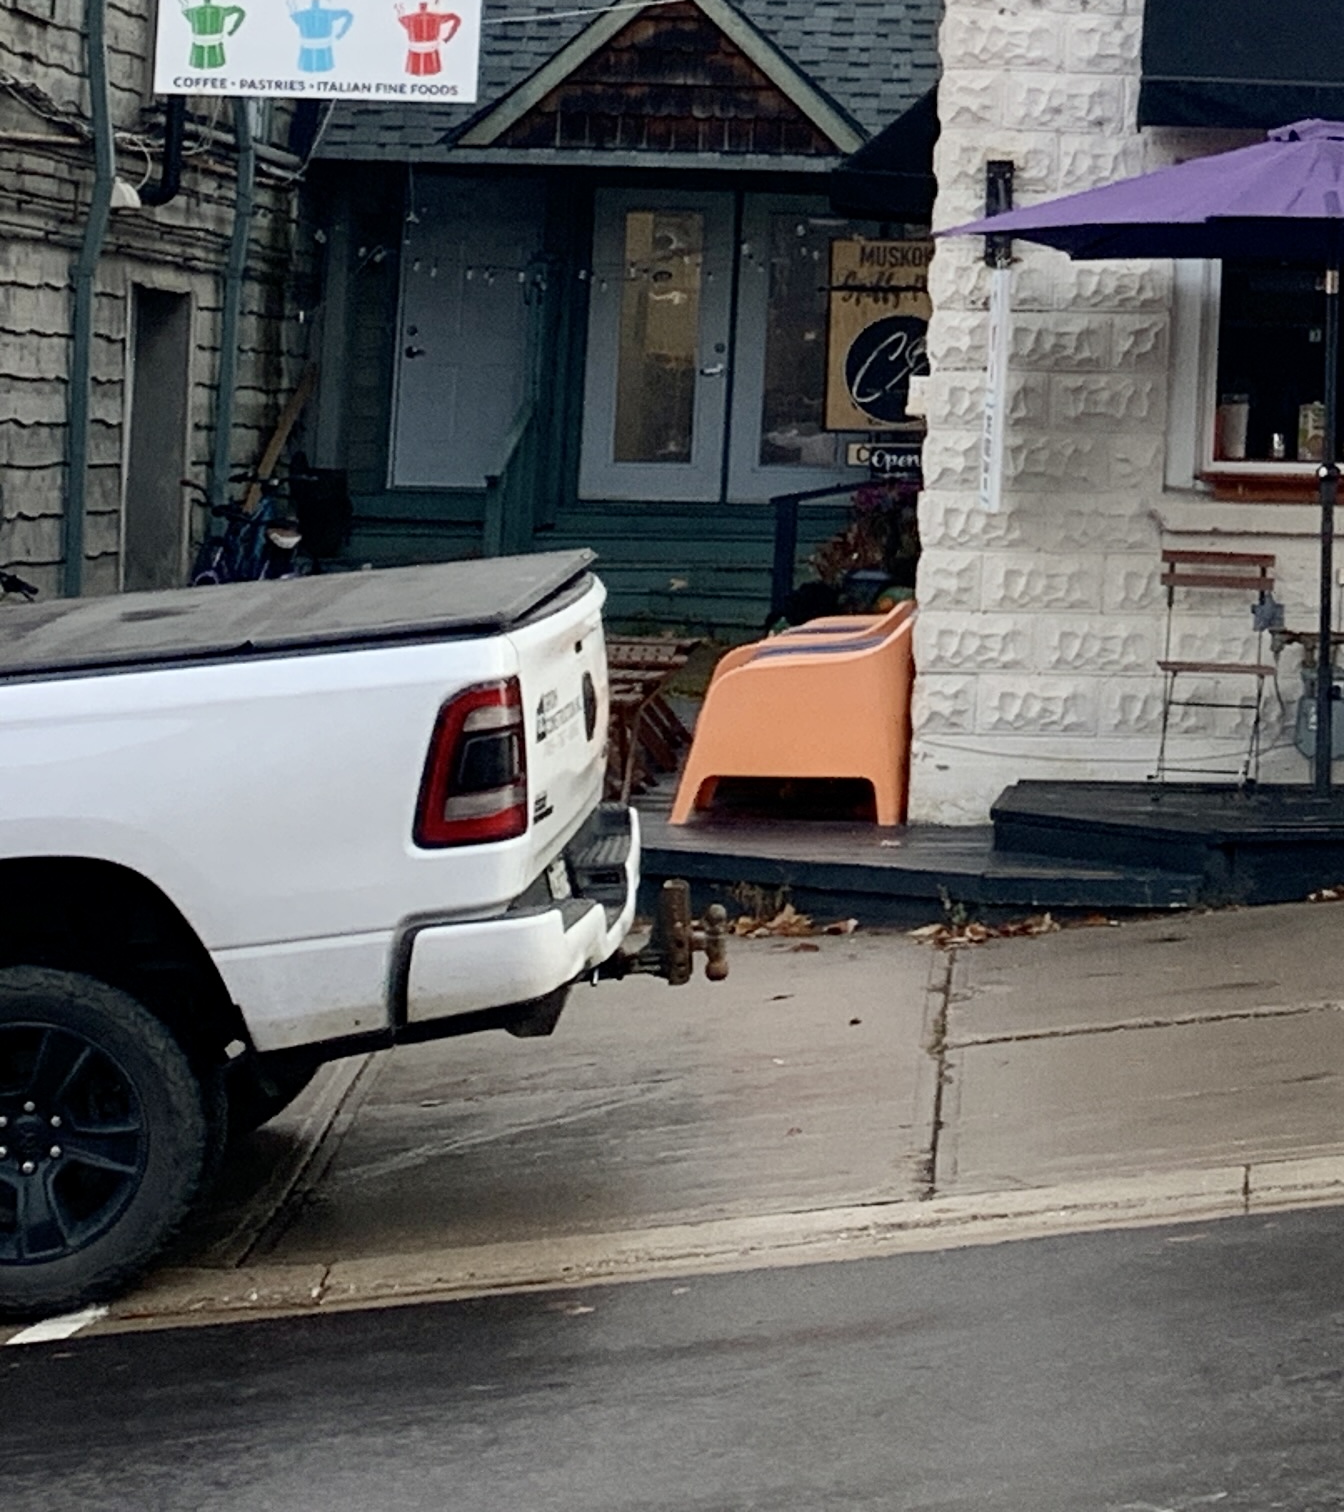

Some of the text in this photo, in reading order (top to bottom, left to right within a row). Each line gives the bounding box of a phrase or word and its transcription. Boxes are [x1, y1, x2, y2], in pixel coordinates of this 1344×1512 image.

[173, 76, 459, 96] COFFEE PASTRIES ITALIAN FINE FOODS
